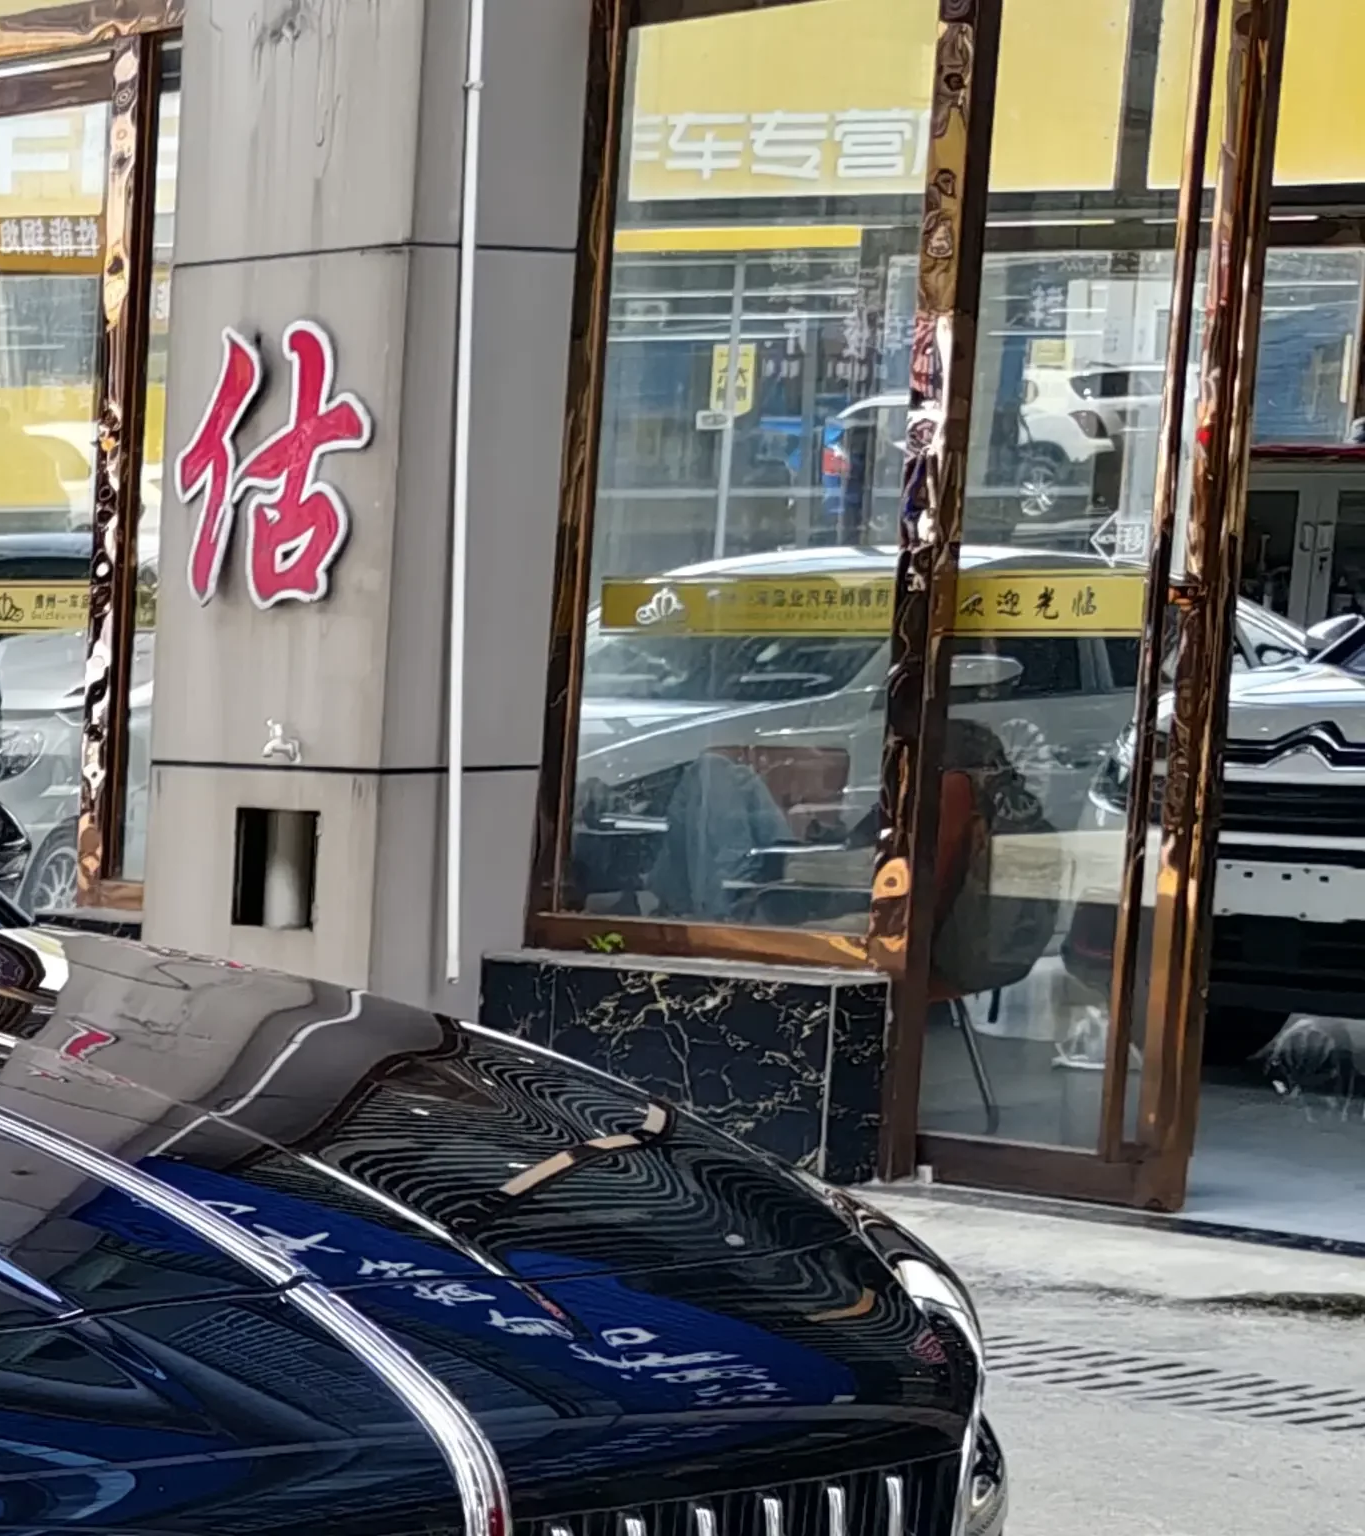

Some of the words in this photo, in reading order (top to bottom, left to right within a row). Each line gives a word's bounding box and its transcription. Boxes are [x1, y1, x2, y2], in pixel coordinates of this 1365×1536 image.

[175, 319, 372, 610] 估
[959, 585, 1098, 620] 欢迎光临
